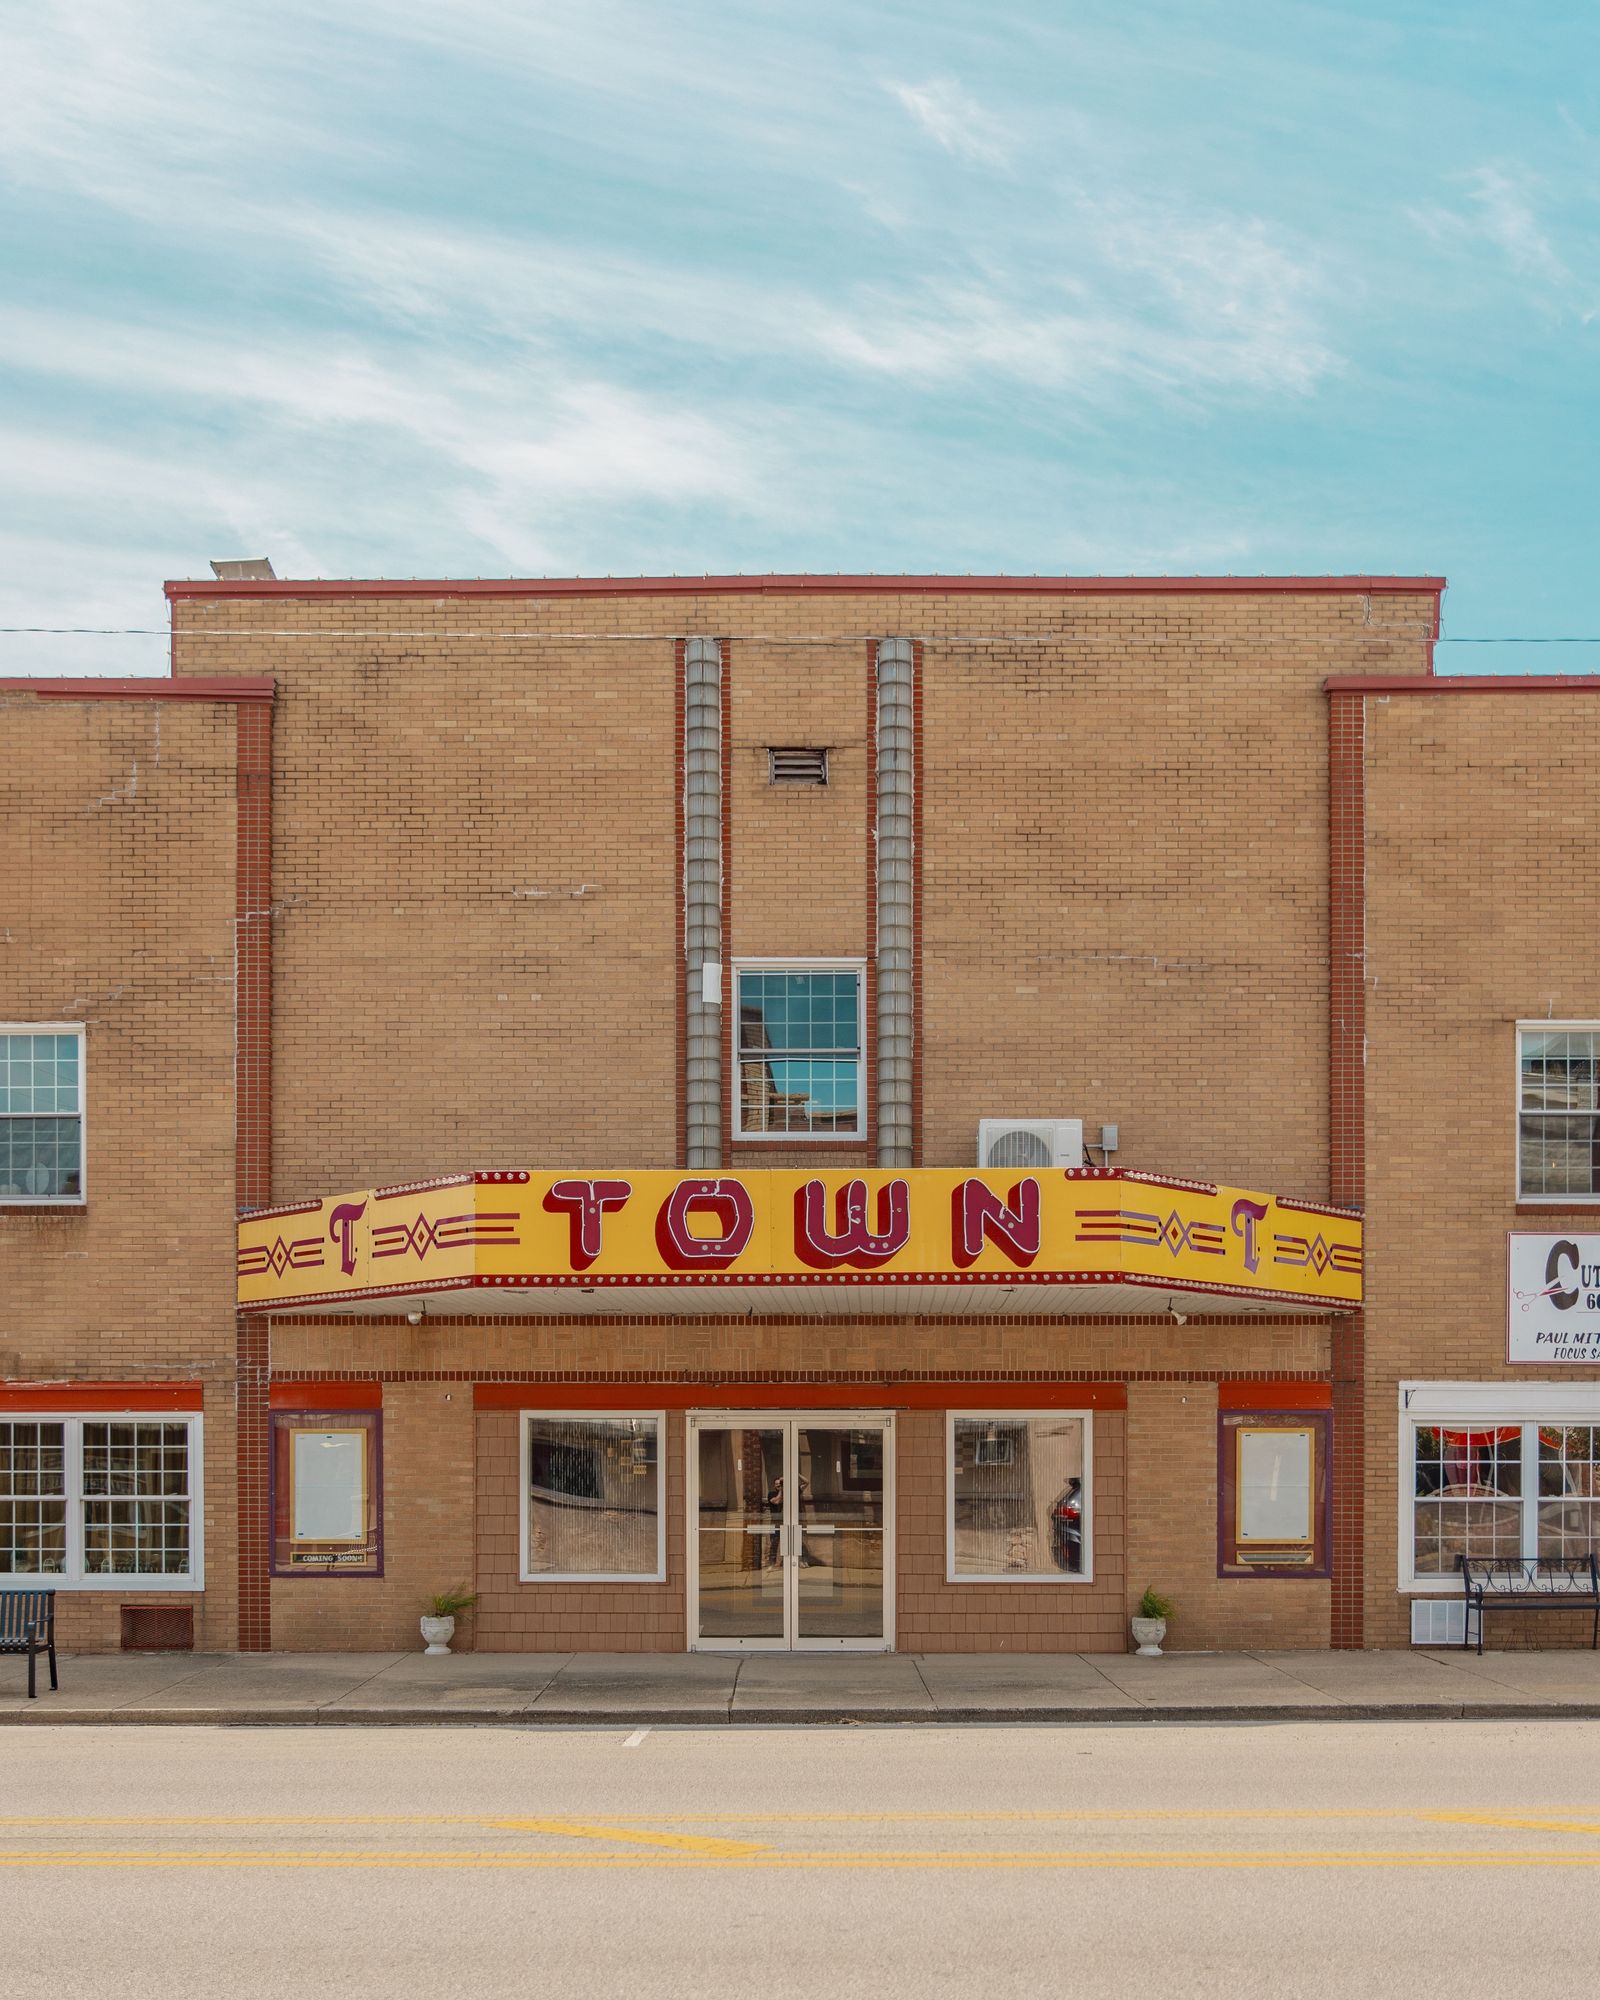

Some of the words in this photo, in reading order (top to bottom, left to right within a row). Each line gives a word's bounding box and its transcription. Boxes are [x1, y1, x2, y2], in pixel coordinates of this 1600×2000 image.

[542, 1177, 1041, 1271] TOWN
[1535, 1332, 1569, 1344] PAUL
[1554, 1347, 1587, 1359] FOCUS
